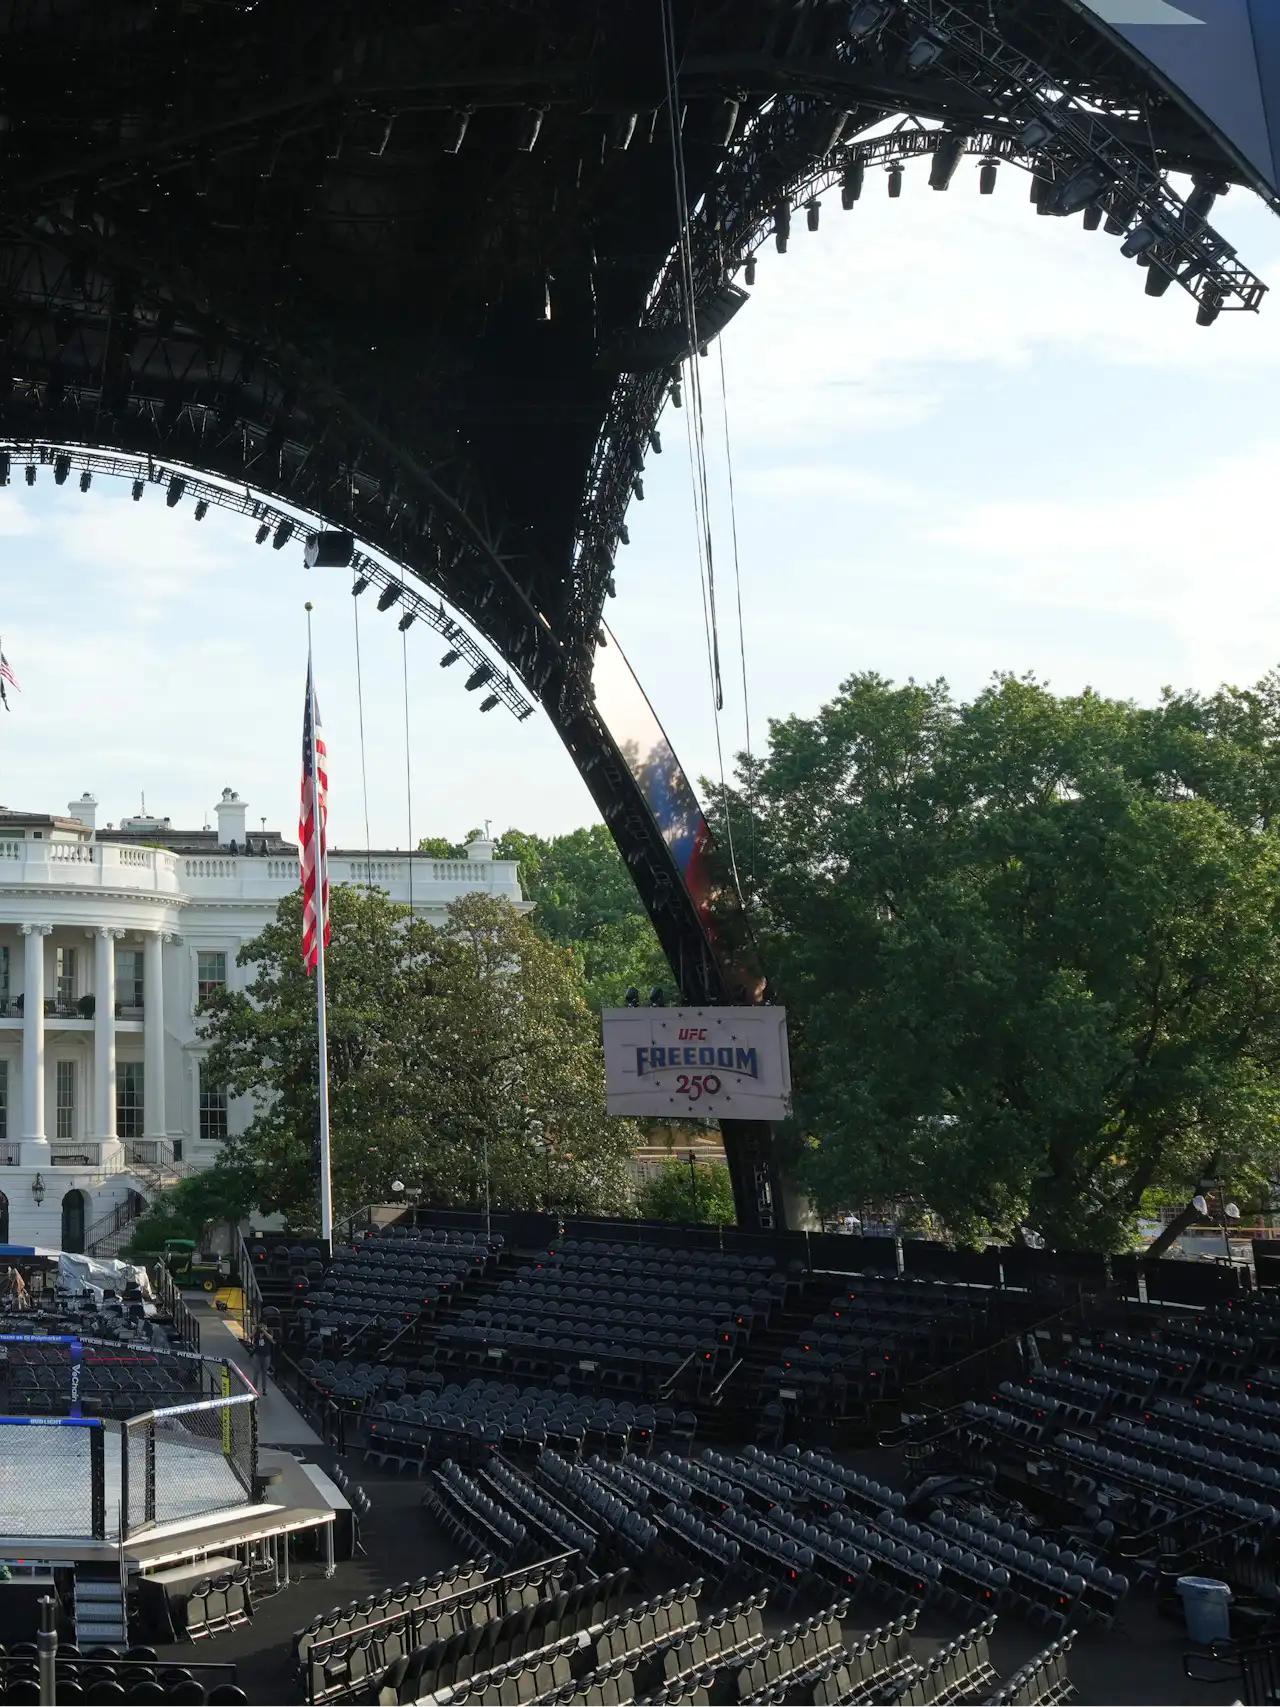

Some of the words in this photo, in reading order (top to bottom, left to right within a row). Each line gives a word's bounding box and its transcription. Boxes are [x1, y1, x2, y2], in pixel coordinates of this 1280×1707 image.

[678, 1028, 708, 1041] UFC
[636, 1047, 758, 1079] FREEDOM
[675, 1074, 721, 1102] 250
[71, 1364, 81, 1402] VeChain
